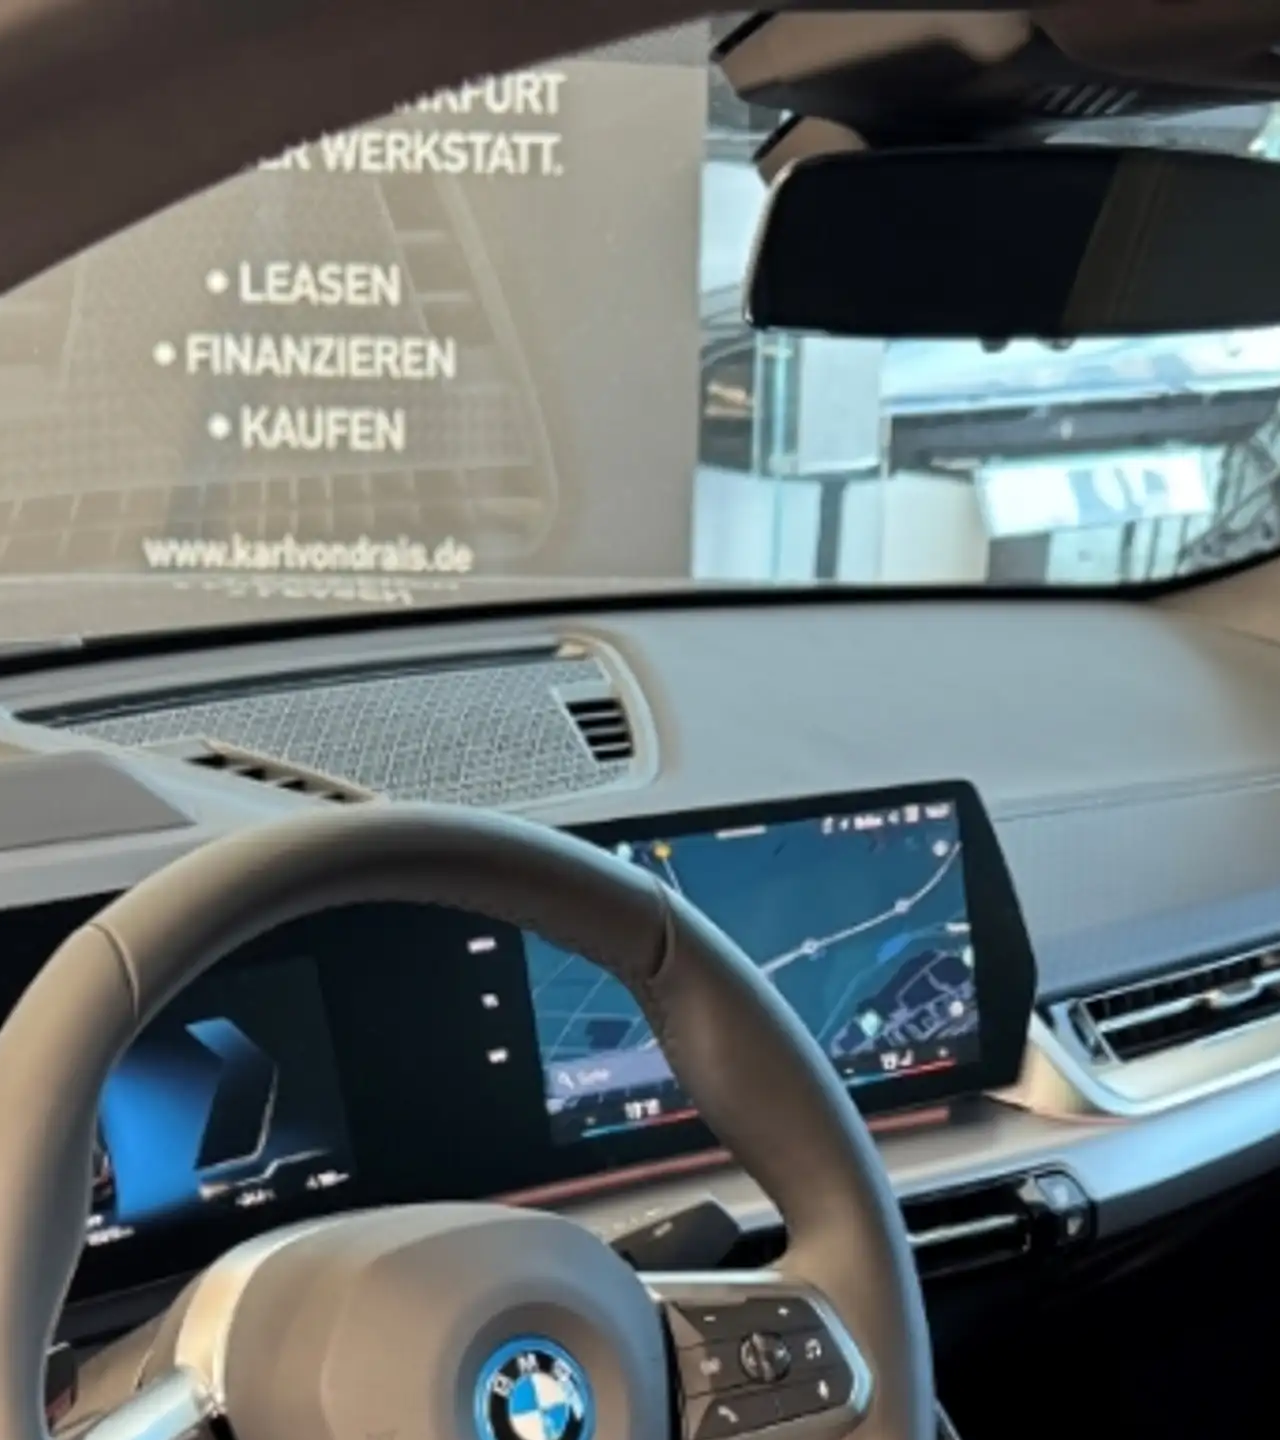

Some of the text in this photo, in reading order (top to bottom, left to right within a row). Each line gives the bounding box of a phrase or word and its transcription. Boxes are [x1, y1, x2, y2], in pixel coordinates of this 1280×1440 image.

[322, 130, 565, 176] WERKSTATT.
[239, 261, 401, 306] LEASEN
[186, 334, 457, 380] FINANZIEREN
[240, 404, 407, 452] KAUFEN
[142, 532, 474, 573] www.karlvondrais.de
